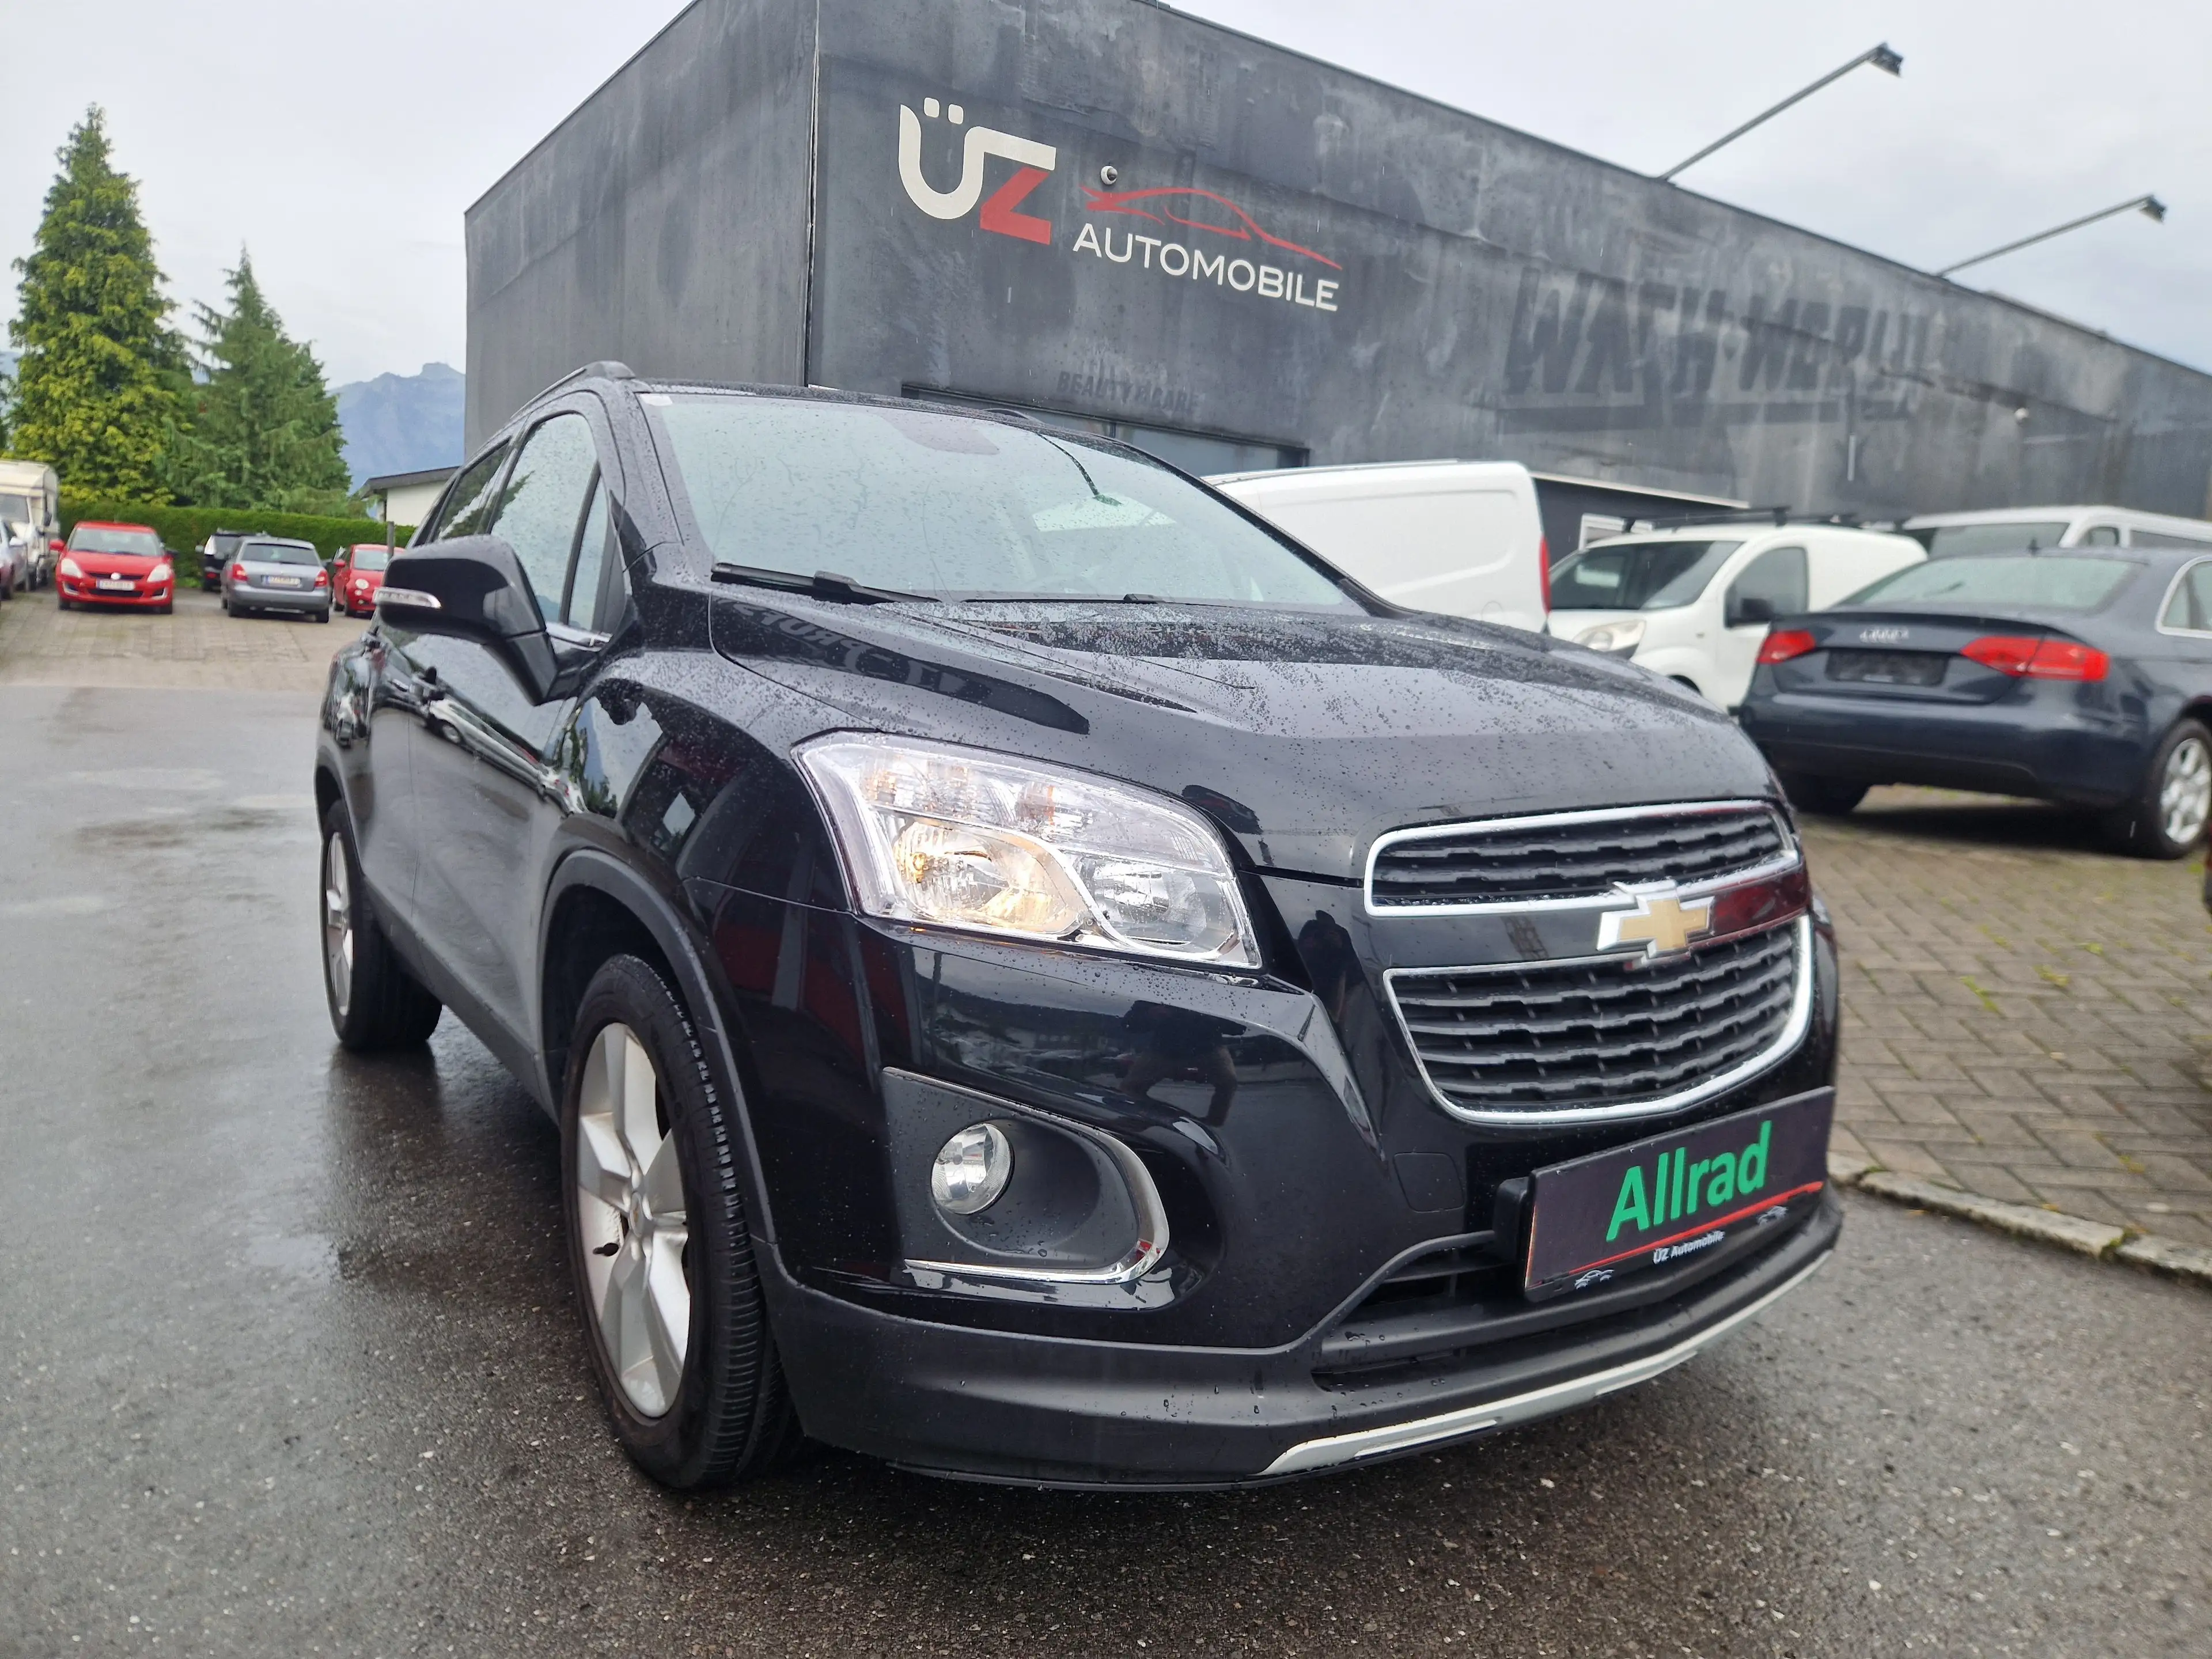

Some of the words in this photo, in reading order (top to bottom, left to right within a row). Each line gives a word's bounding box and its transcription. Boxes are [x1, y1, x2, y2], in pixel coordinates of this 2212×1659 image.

[899, 97, 1056, 245] ÜZ
[1072, 222, 1339, 313] AUTOMOBILE
[1605, 1120, 1772, 1242] Allrad
[1671, 1230, 1726, 1259] Automobile
